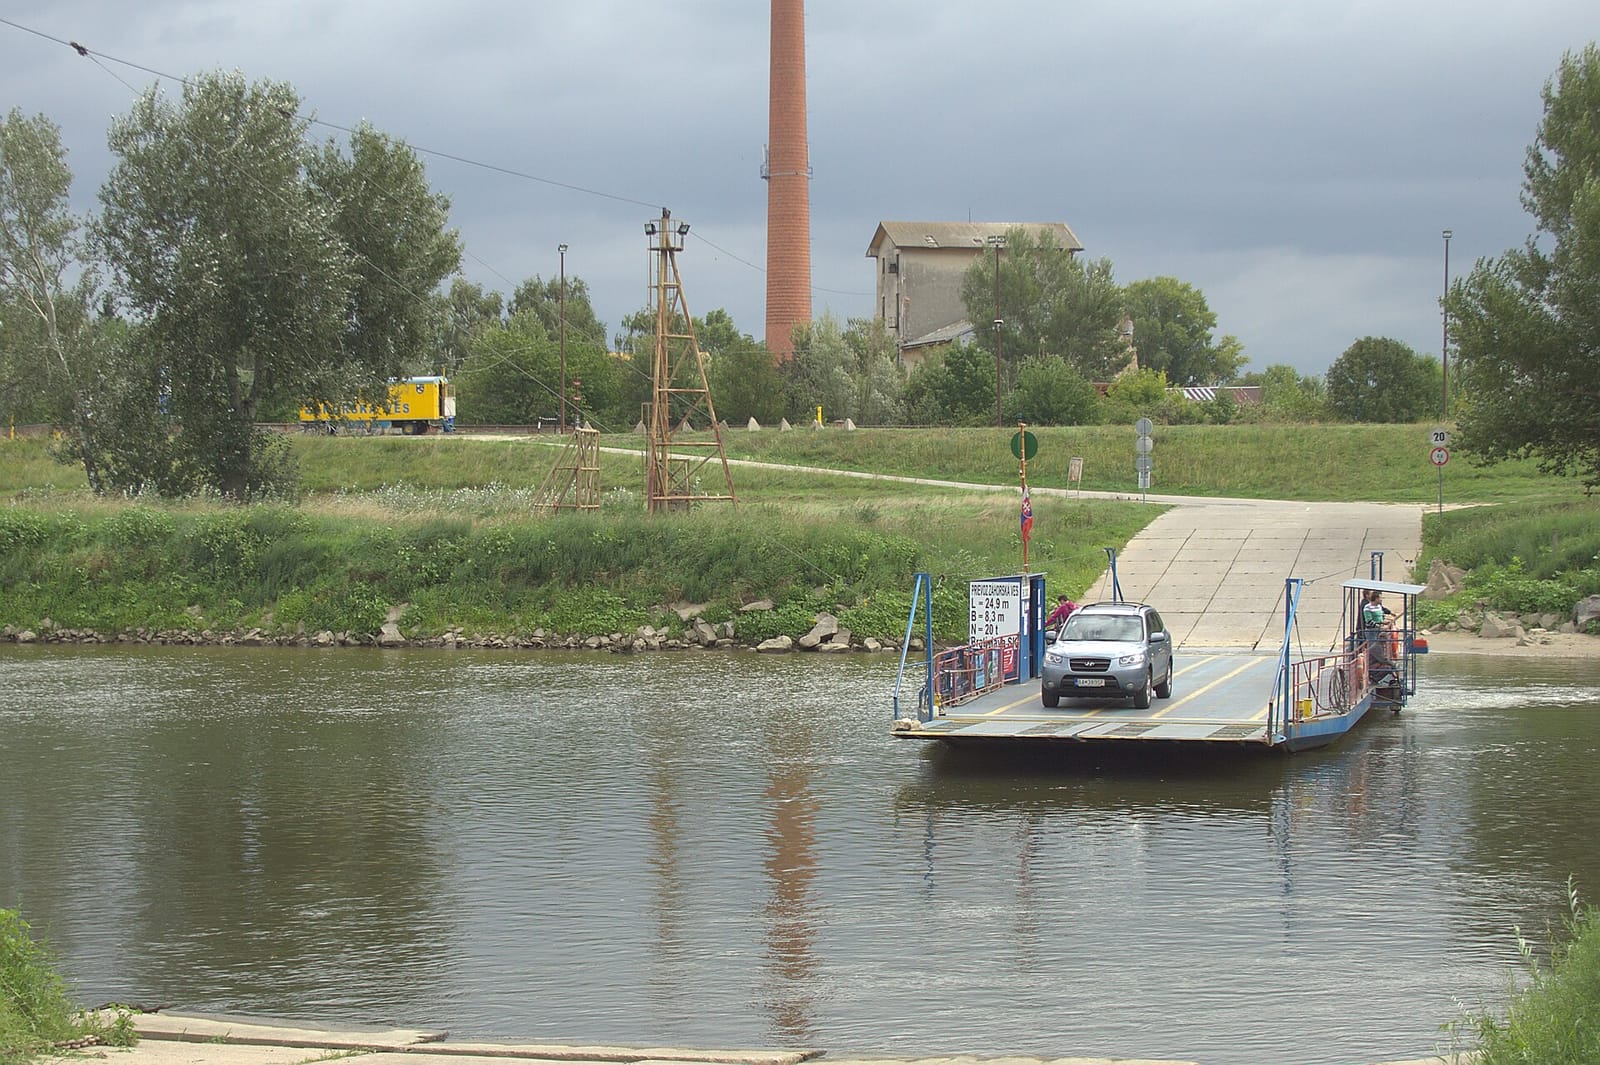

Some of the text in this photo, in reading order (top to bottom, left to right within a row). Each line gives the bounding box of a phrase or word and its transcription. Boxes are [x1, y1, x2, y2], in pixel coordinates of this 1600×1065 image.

[1433, 432, 1445, 441] 20
[1011, 585, 1019, 597] VES
[971, 598, 976, 609] L
[985, 598, 1000, 610] 24,9
[1002, 601, 1009, 609] m
[971, 611, 977, 622] B
[985, 611, 996, 623] 8,3
[998, 613, 1005, 622] m
[971, 624, 977, 635] N
[985, 624, 993, 635] 20
